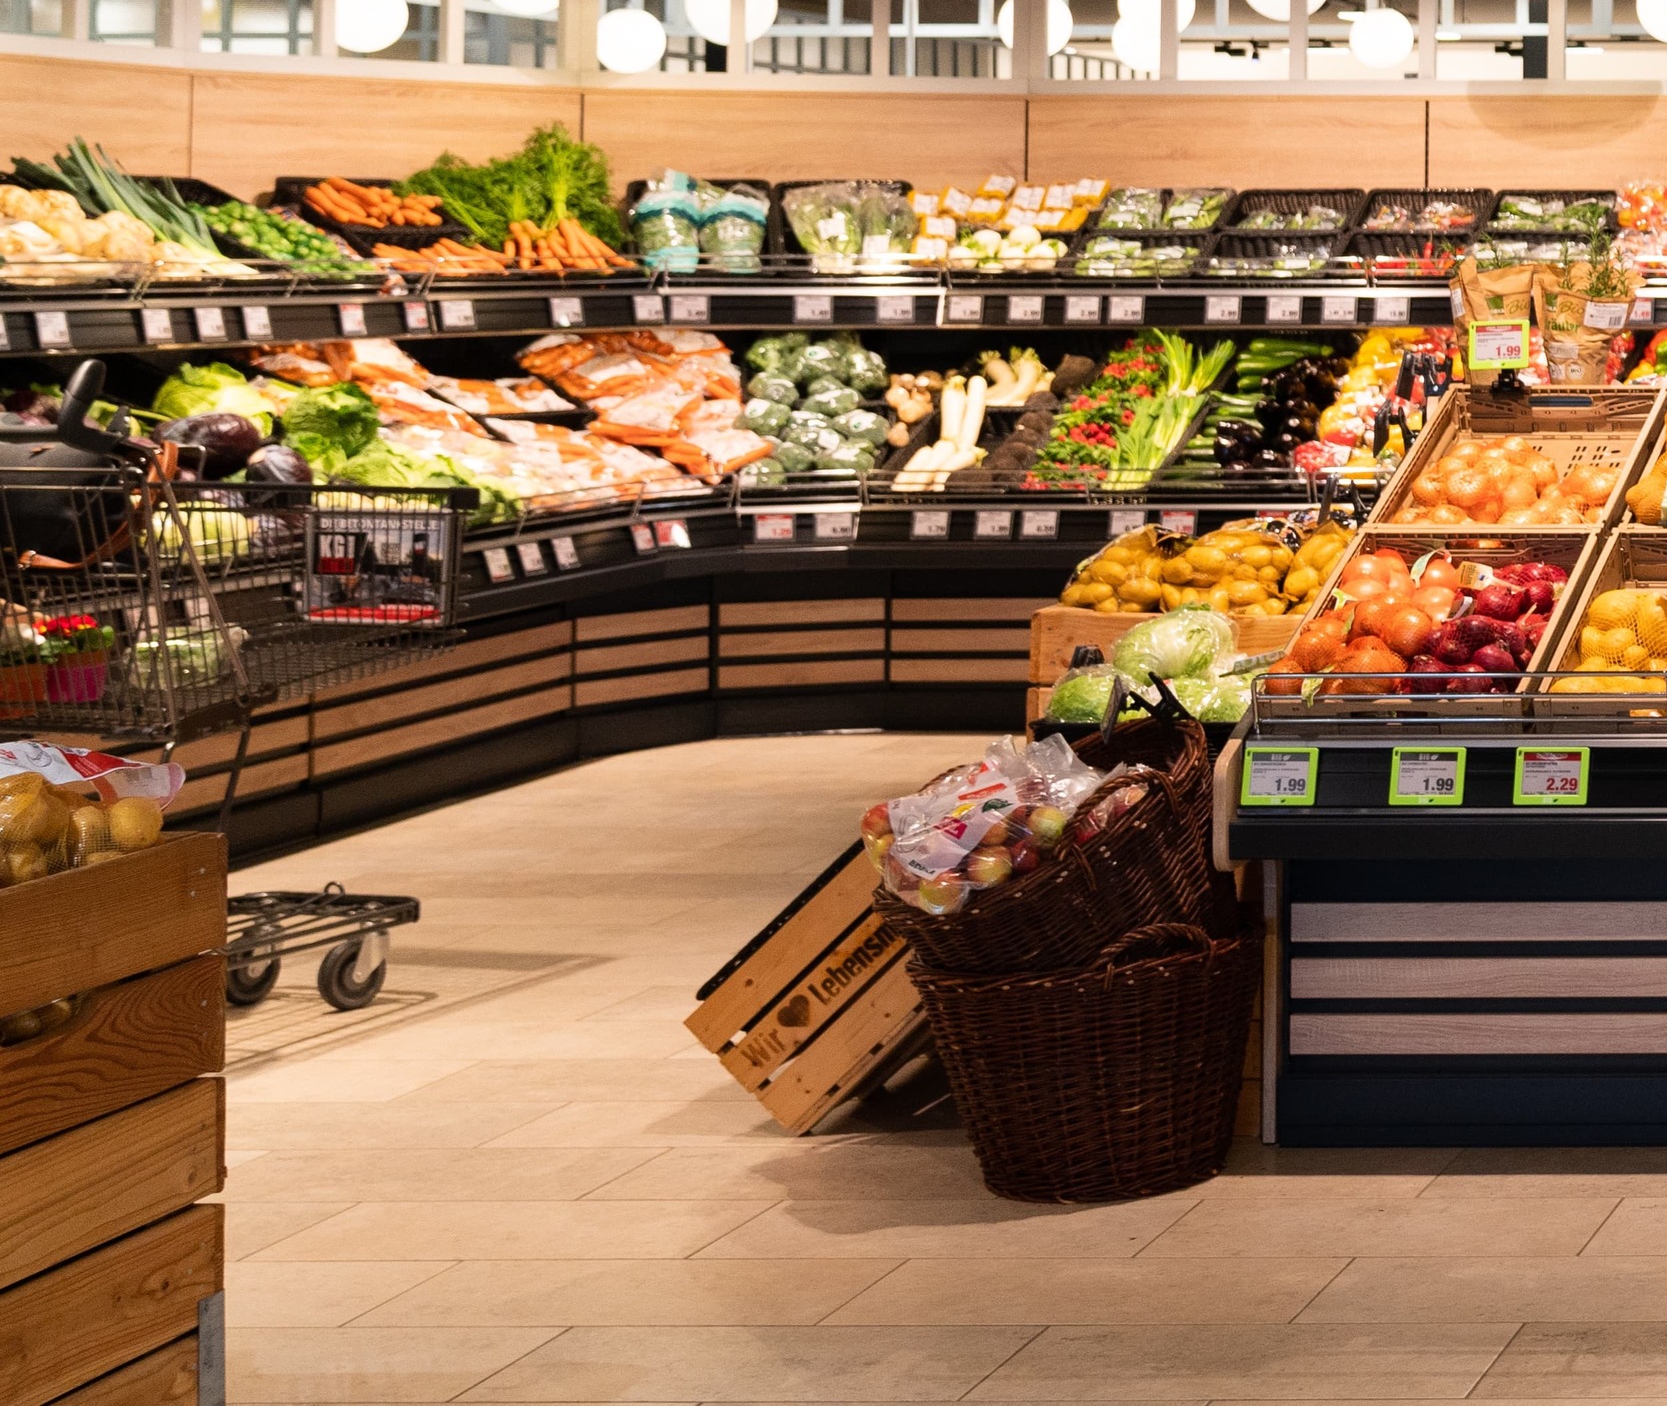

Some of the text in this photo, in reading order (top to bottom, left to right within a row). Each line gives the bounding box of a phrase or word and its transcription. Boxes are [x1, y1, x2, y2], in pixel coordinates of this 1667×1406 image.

[1496, 345, 1521, 357] 1.99
[1275, 778, 1306, 791] 1.99
[1423, 778, 1454, 791] 1.99
[1546, 778, 1578, 791] 2.29
[740, 923, 902, 1069] Wir Lebensm
